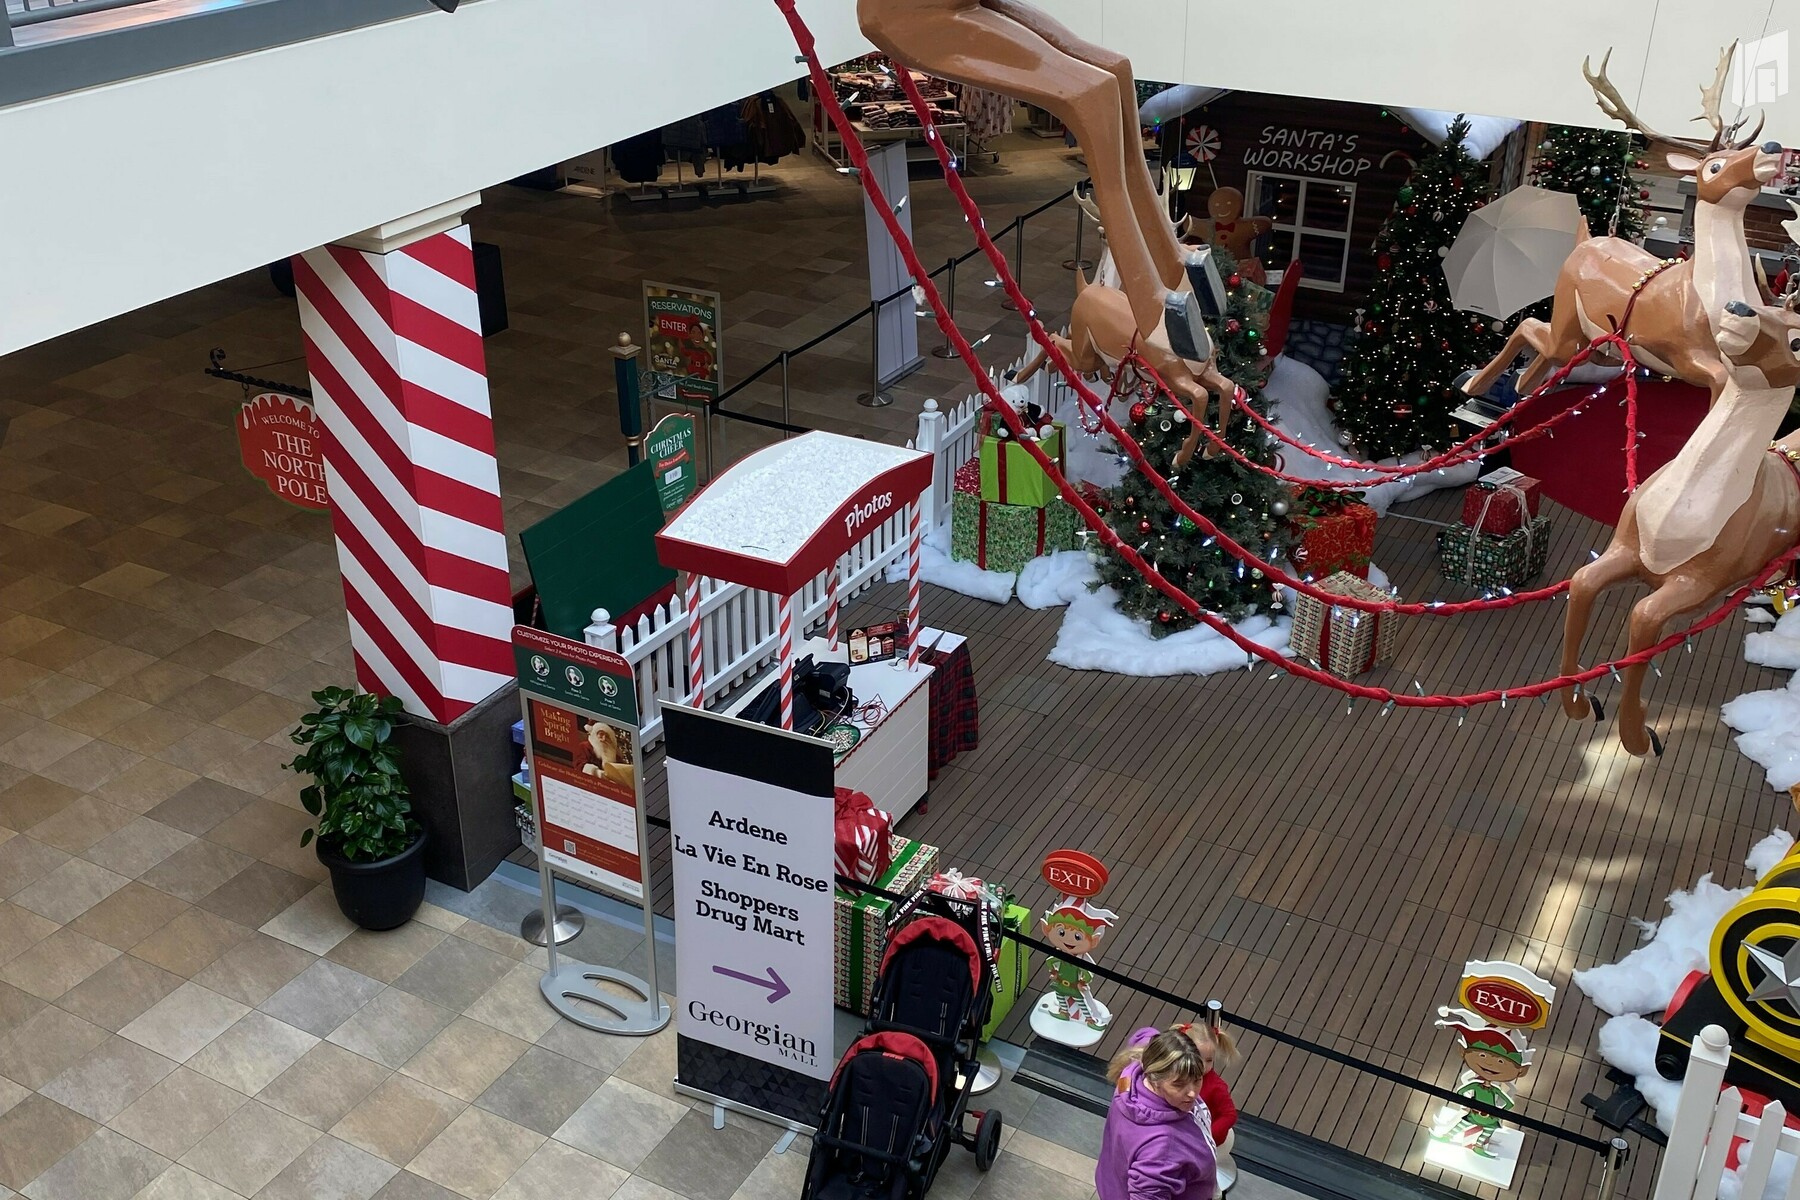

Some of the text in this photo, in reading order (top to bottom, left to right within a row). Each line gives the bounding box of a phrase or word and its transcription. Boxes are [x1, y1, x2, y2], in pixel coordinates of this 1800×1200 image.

[1258, 126, 1359, 153] SANTA'S
[1243, 148, 1372, 176] WORKSHOP
[651, 300, 712, 320] RESERVATIONS
[661, 320, 688, 332] ENTER
[654, 354, 678, 366] SANTA
[261, 414, 320, 439] WELCOME TO
[272, 430, 313, 458] THE
[650, 428, 692, 454] CHRISTMAS
[660, 440, 684, 458] CHEER
[276, 474, 328, 504] POLE
[516, 630, 624, 666] CUSTOMIZE YOUR PHOTO EXPERIENCE
[540, 708, 571, 726] Making
[543, 718, 570, 734] Spirits
[544, 727, 570, 744] Bright
[708, 810, 788, 846] Ardene
[674, 834, 828, 892] La Vie En Rose
[1048, 866, 1094, 890] EXIT
[700, 880, 799, 922] Shoppers
[696, 899, 806, 946] Drug Mart
[1474, 989, 1532, 1018] EXIT
[688, 1000, 818, 1058] Georgian
[778, 1048, 818, 1068] MALL
